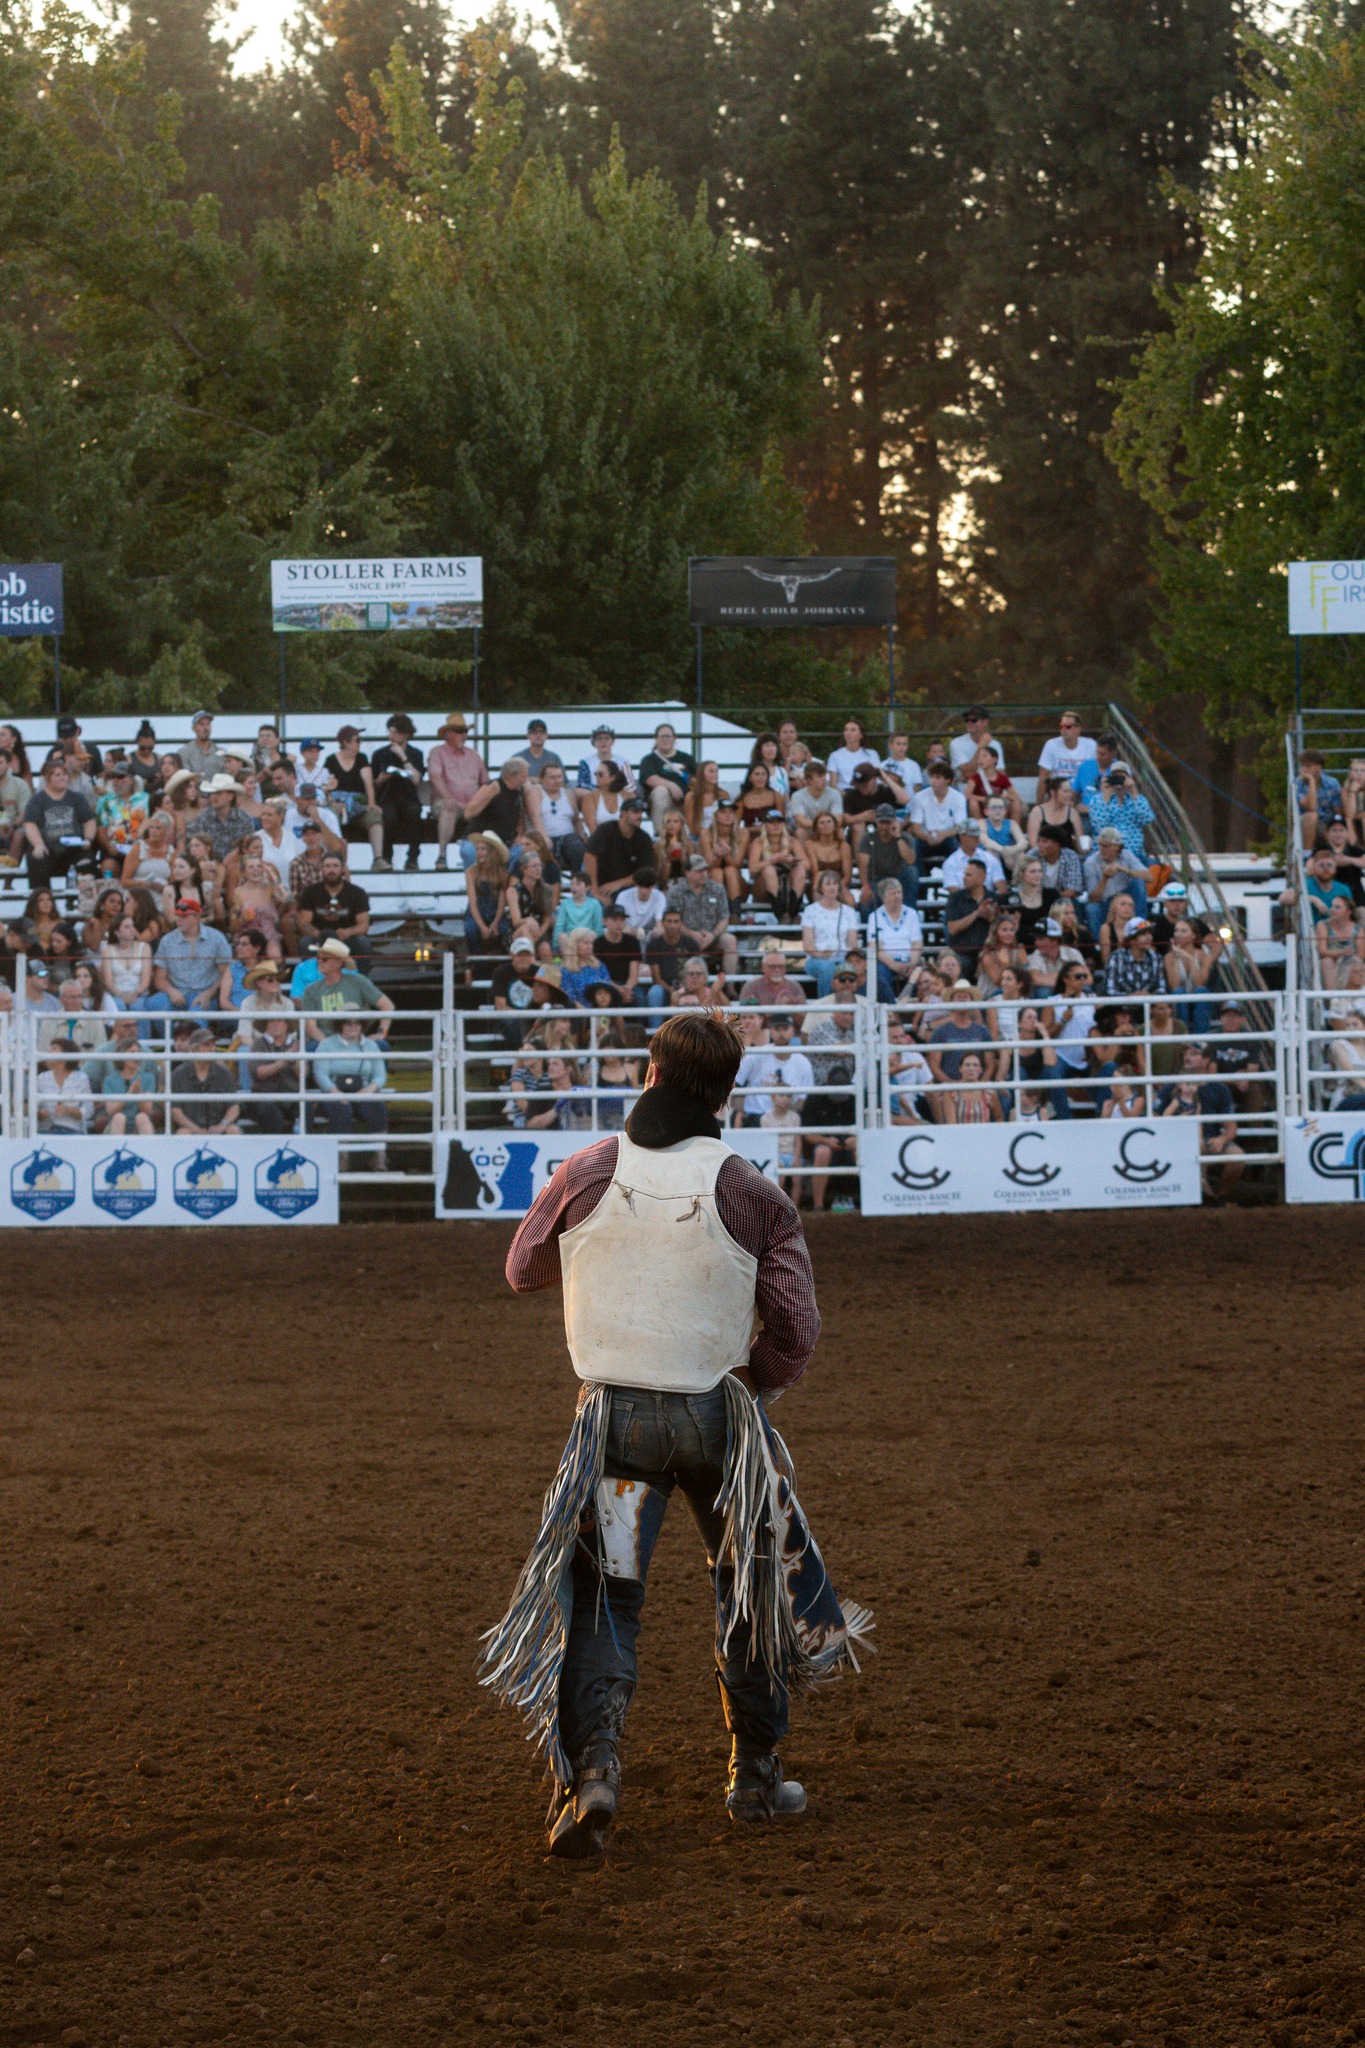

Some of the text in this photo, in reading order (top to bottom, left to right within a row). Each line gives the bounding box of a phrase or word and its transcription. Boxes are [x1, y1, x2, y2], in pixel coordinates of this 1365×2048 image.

[287, 562, 467, 580] STOLLER FARMS
[348, 582, 381, 590] SINCE
[0, 599, 55, 624] istie
[720, 606, 866, 615] REBEL CHILD JOURNEYS
[475, 1155, 505, 1166] OC
